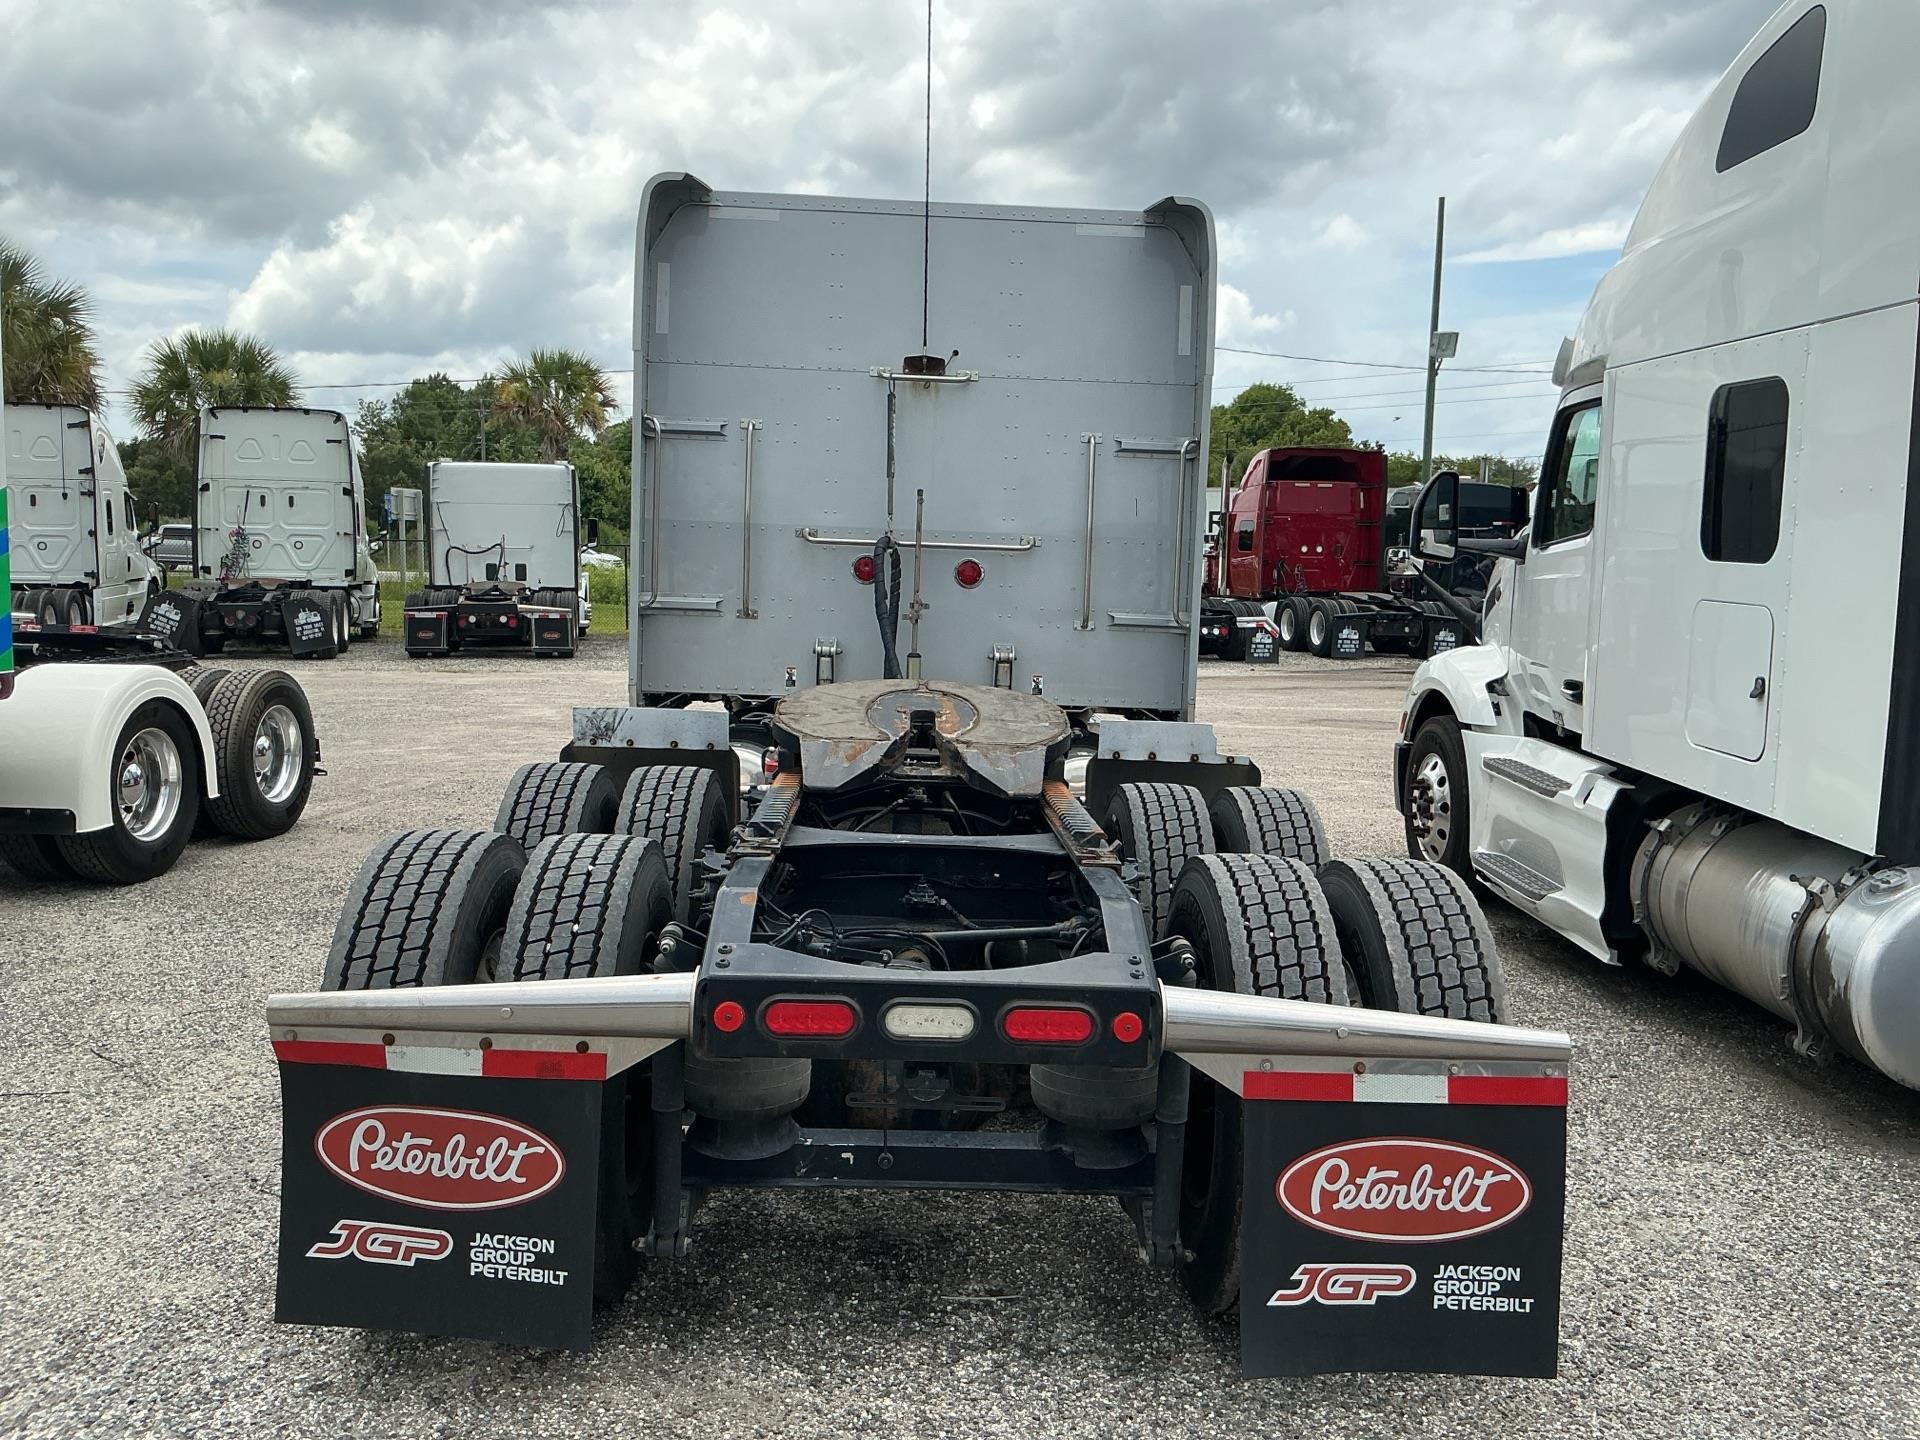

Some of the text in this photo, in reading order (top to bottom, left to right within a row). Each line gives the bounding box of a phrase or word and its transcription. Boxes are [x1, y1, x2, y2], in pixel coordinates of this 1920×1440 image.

[349, 1117, 546, 1184] Peterbilt
[1310, 1157, 1512, 1215] Peterbilt
[304, 1219, 454, 1267] JGP
[469, 1232, 555, 1255] JACKSON
[469, 1248, 536, 1267] GROUP
[469, 1262, 568, 1286] PETERBILT
[1265, 1263, 1417, 1306] JGP
[1433, 1264, 1521, 1282] JACKSON
[1433, 1280, 1501, 1297] GROUP
[1433, 1295, 1535, 1313] PETERBILT
